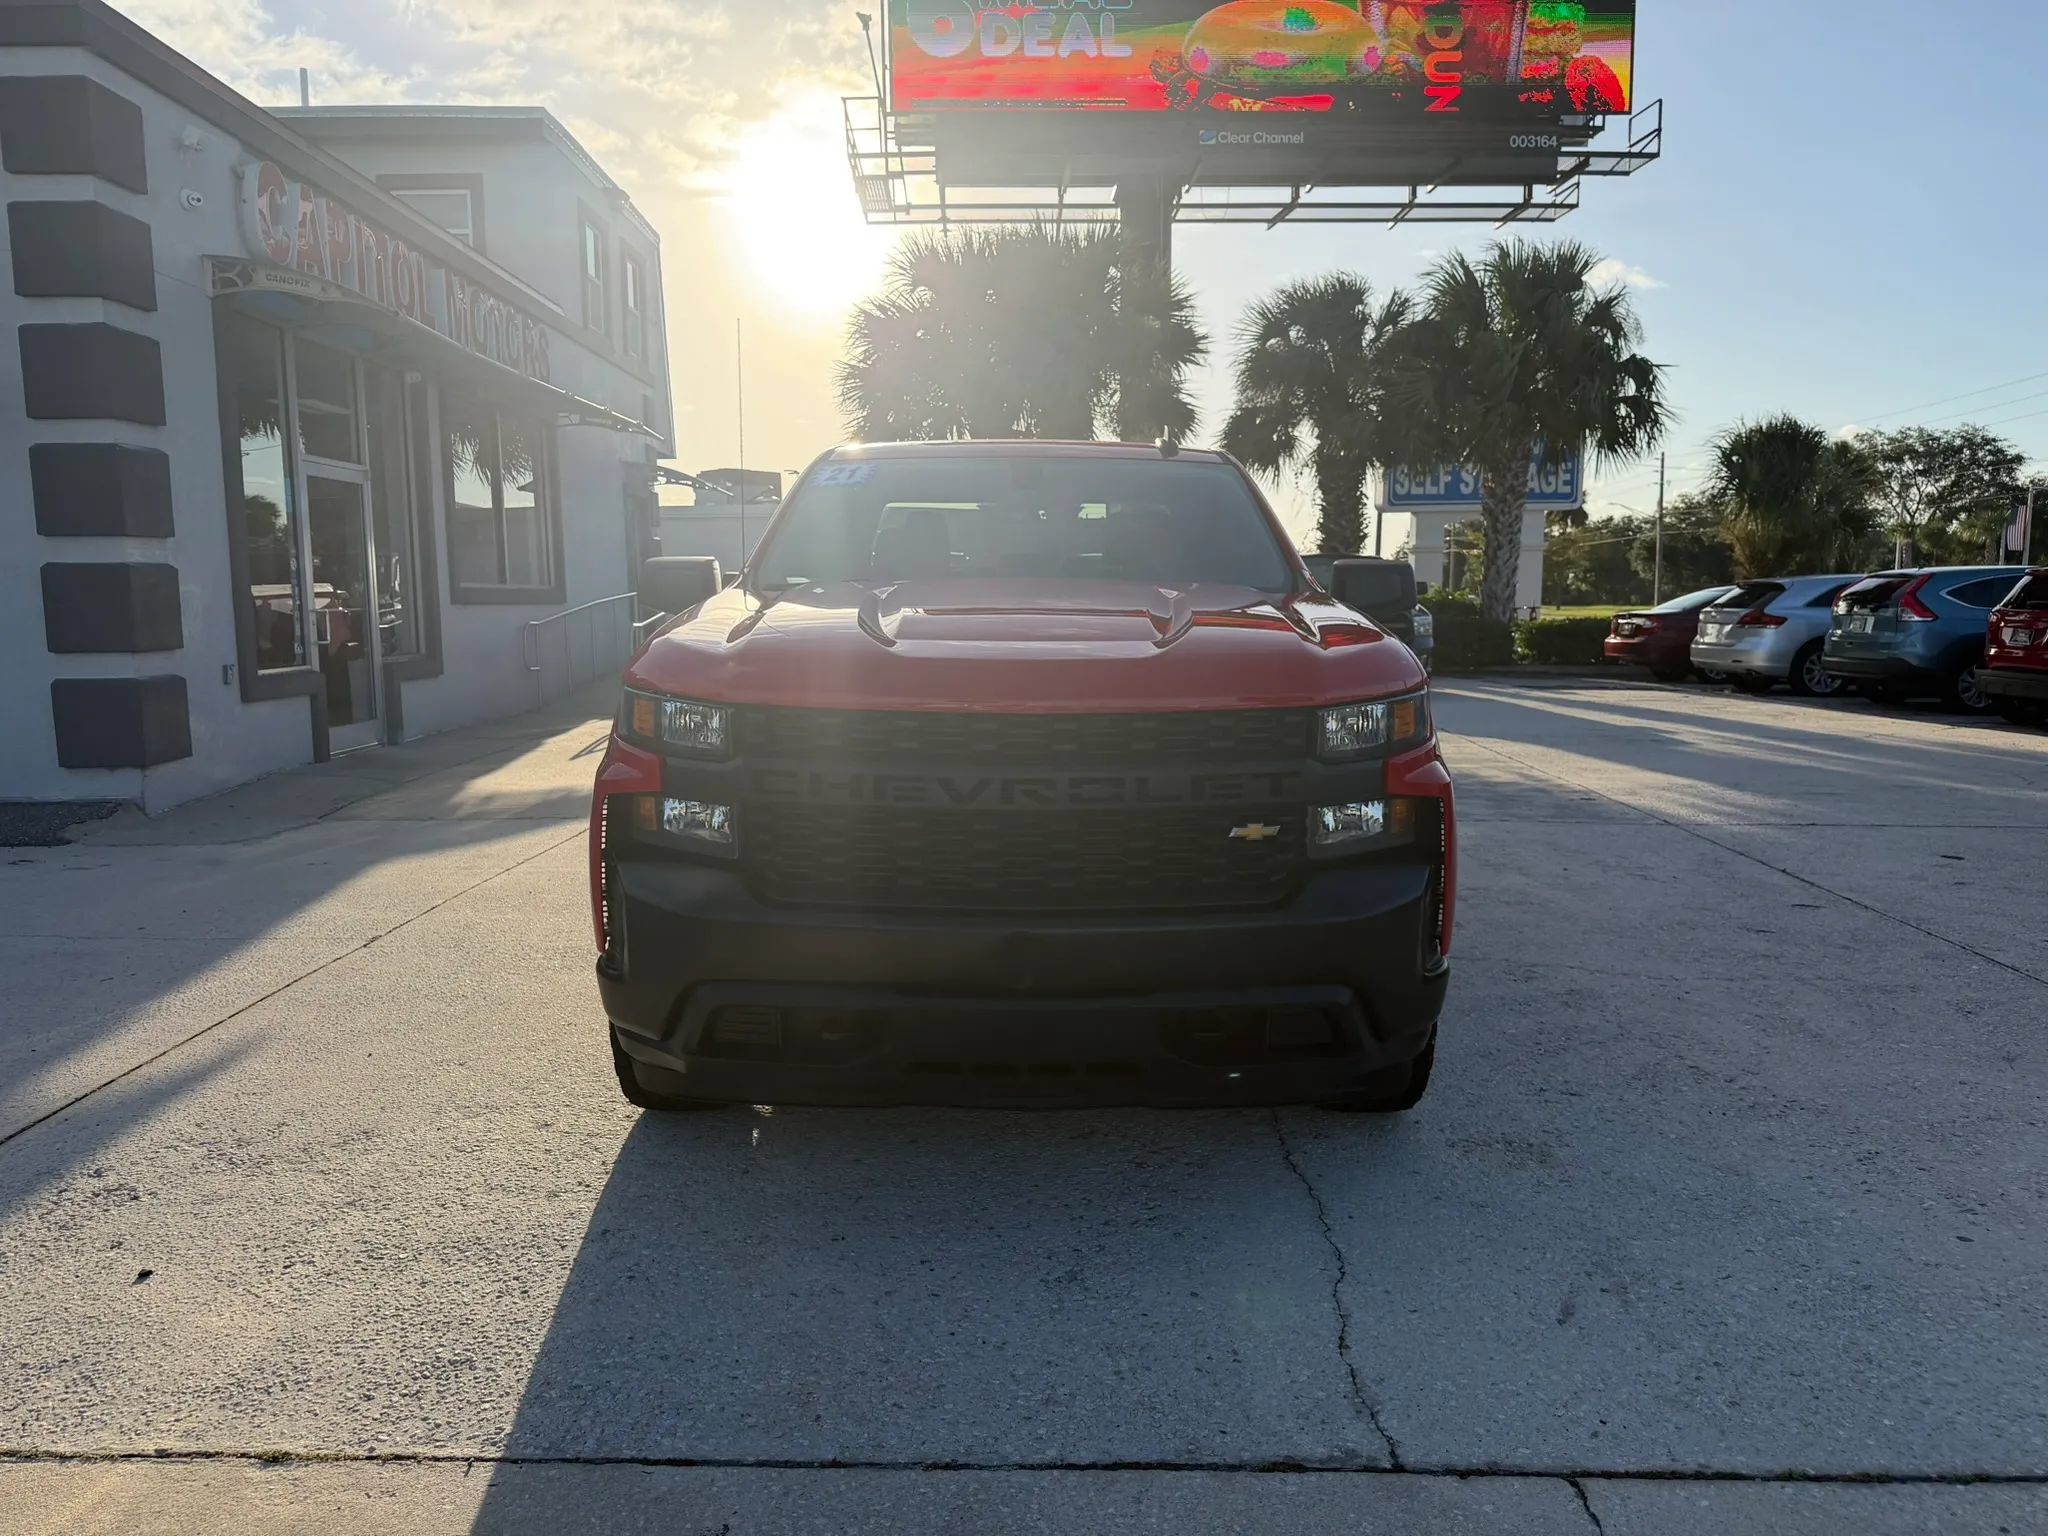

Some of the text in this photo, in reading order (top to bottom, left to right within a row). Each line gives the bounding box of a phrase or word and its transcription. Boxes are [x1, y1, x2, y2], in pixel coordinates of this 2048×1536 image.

[979, 12, 1133, 58] DEAL
[1217, 131, 1305, 144] Clear Channel
[1509, 135, 1558, 148] 003164
[252, 161, 551, 383] CAPITOL MOTORS
[1395, 463, 1453, 495] SELF
[749, 768, 1303, 806] CHEVROLET
